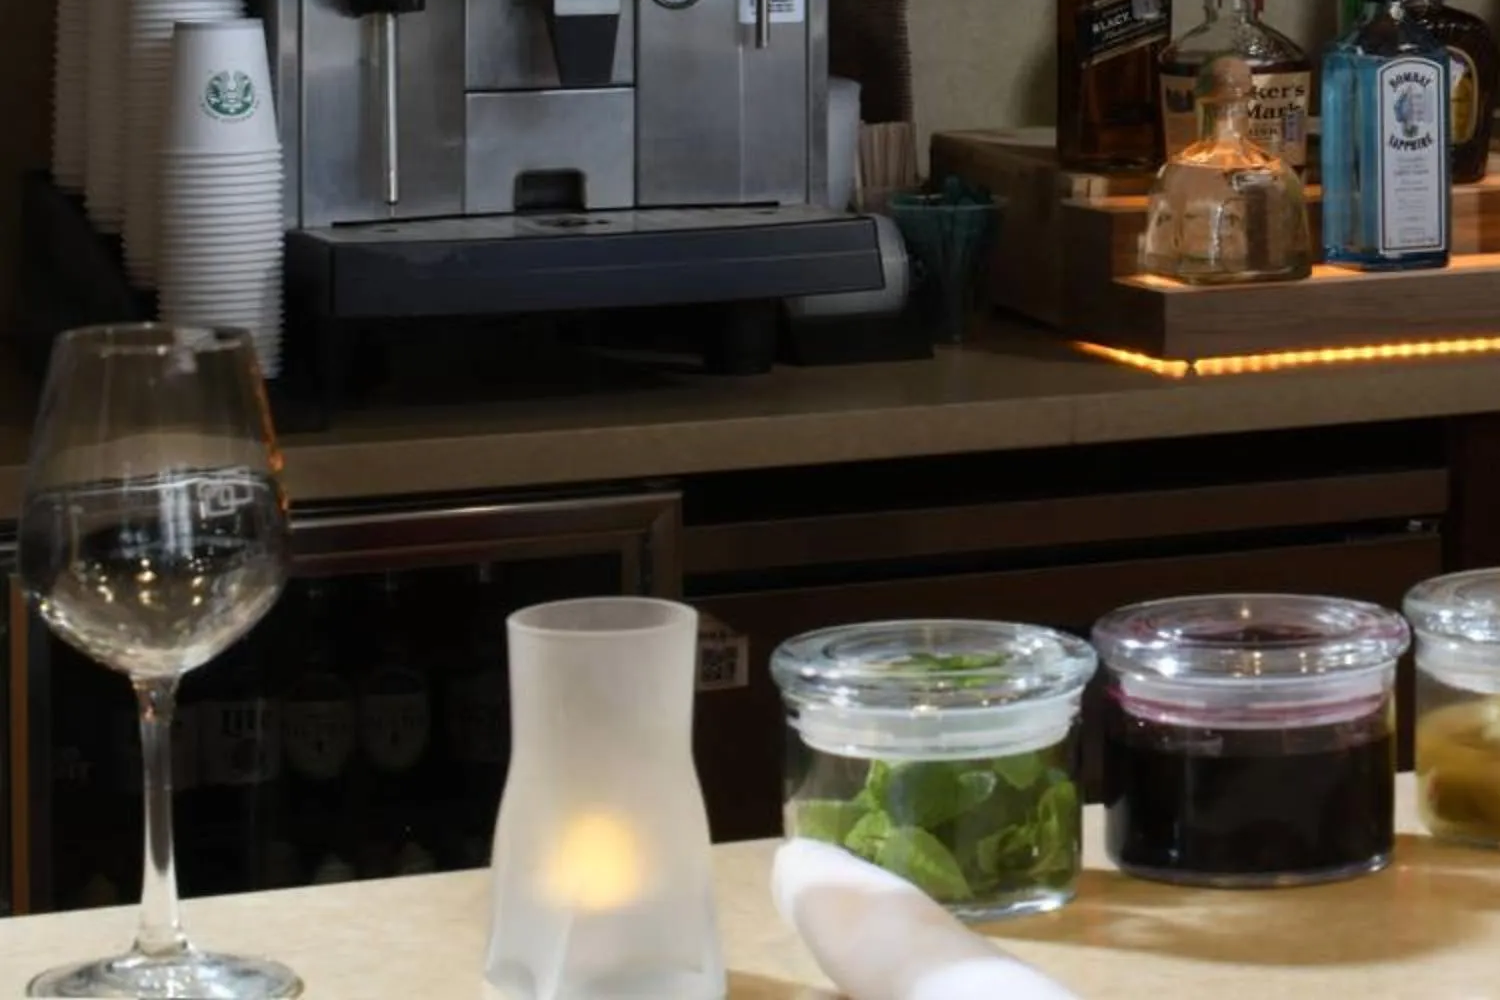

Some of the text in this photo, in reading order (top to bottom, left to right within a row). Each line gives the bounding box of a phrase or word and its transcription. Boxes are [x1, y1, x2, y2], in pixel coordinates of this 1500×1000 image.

[1389, 71, 1433, 91] BOMBAY
[1247, 84, 1305, 100] ker's
[1389, 133, 1434, 151] SAPPHIRE
